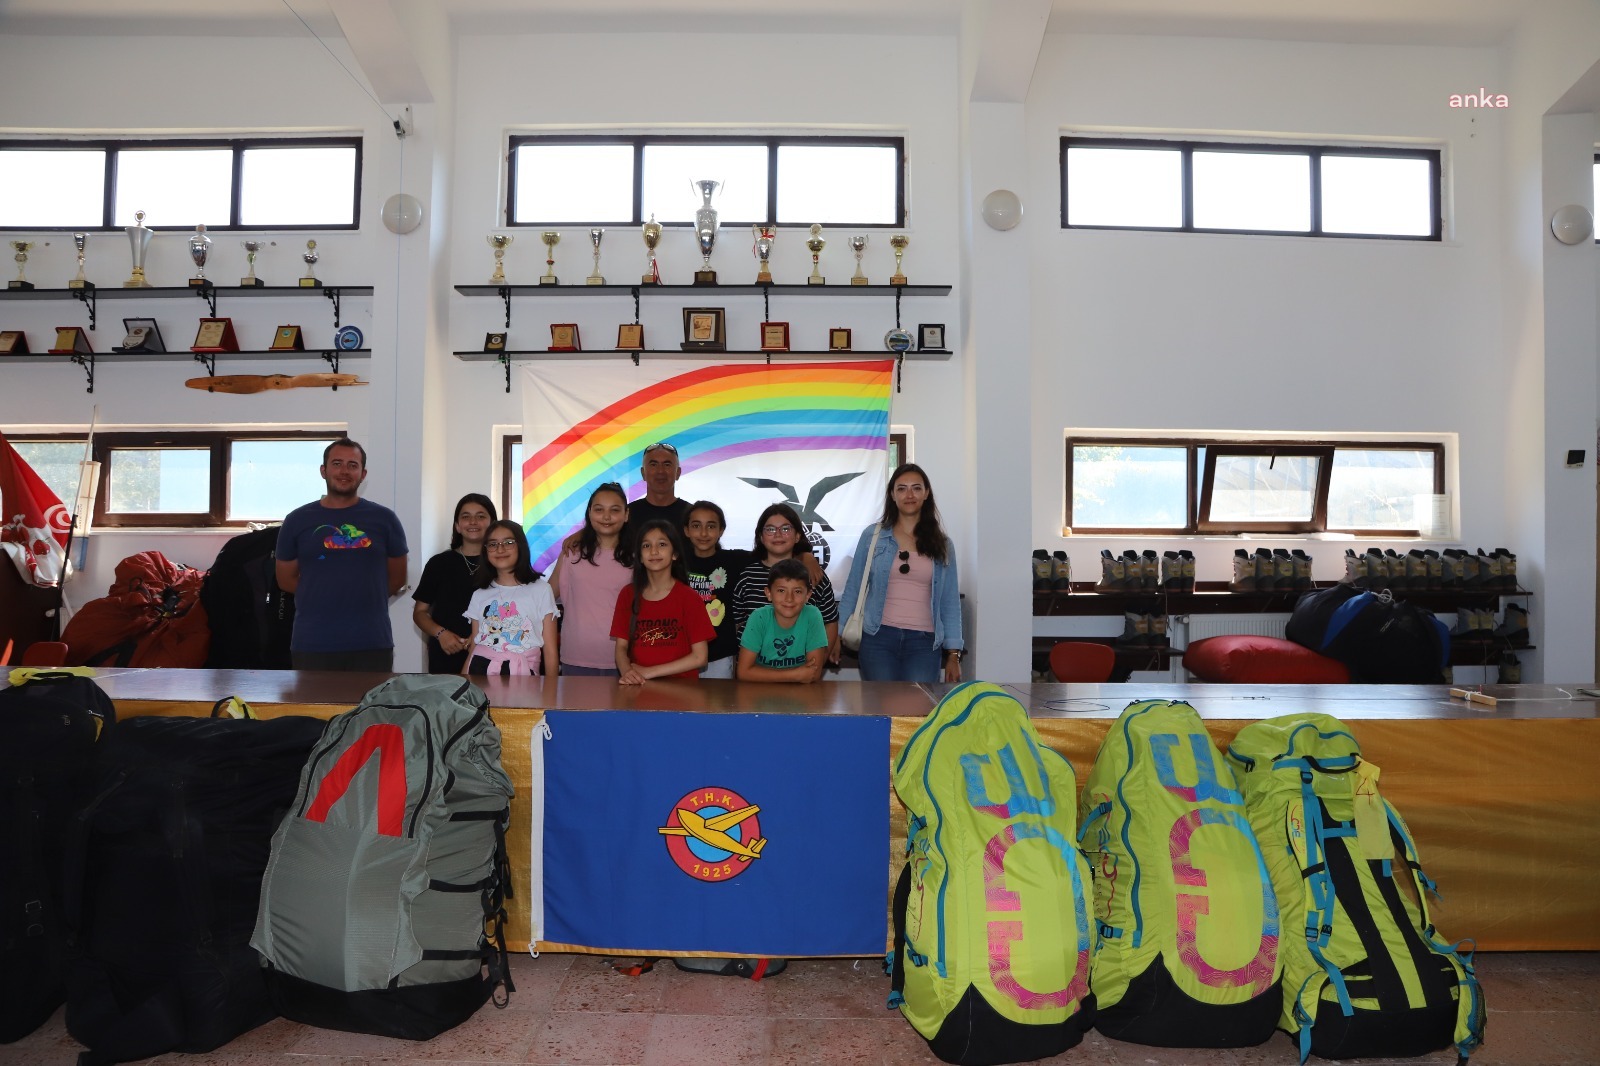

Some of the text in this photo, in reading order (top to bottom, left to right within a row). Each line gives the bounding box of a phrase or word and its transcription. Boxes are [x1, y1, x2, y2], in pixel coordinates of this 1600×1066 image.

[1355, 776, 1376, 806] 4
[690, 792, 735, 809] T.H.K.
[693, 864, 732, 878] 1925
